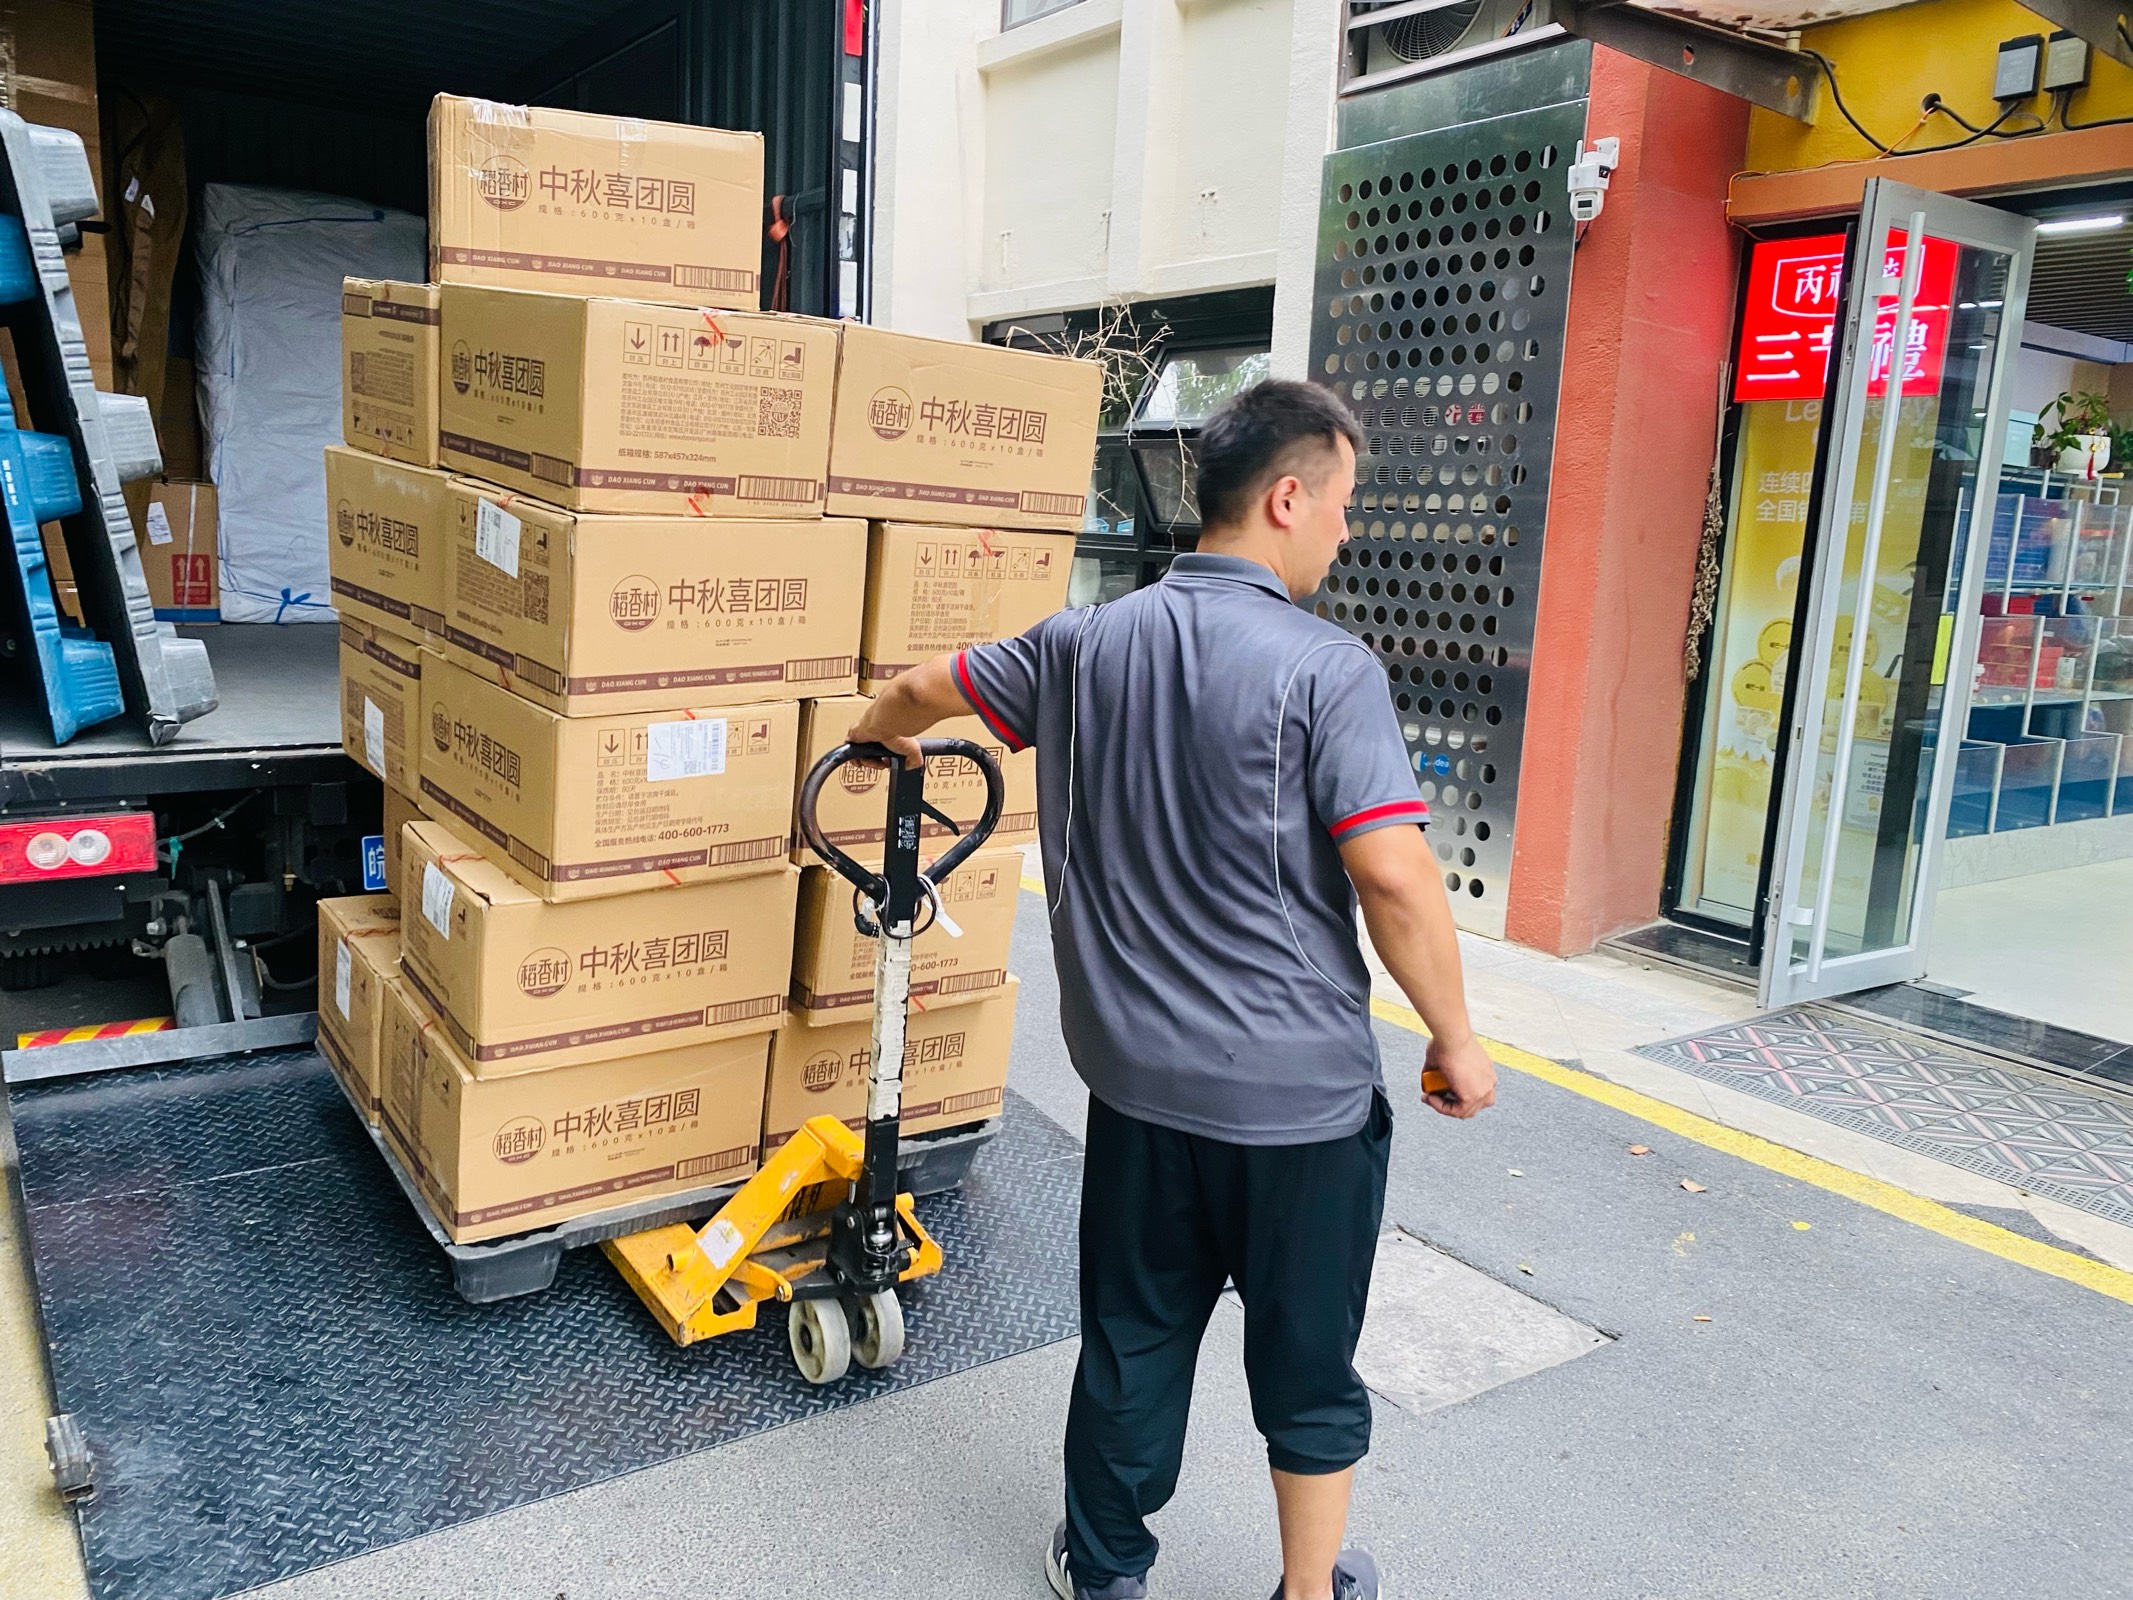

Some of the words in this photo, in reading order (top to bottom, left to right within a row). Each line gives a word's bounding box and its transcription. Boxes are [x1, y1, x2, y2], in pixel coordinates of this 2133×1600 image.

[481, 168, 528, 199] 稻香村
[539, 164, 695, 216] 中秋喜团圆
[635, 268, 652, 277] XIANG
[654, 270, 666, 278] CUN
[474, 348, 545, 399] 中秋喜团圆
[870, 399, 911, 428] 稻香村
[920, 396, 1048, 444] 中秋喜团圆
[623, 477, 643, 485] XIANG
[357, 508, 418, 558] 中秋喜团圆
[612, 588, 658, 618] 稻香村
[668, 578, 808, 615] 中秋喜团圆
[454, 718, 520, 789] 中秋喜团圆
[658, 824, 729, 841] 400-600-1773
[579, 930, 729, 979] 中秋喜团圆
[520, 958, 569, 988] 稻香村
[850, 1032, 965, 1075] 中喜团圆
[804, 1059, 841, 1085] 稻香村
[554, 1088, 700, 1143] 中秋喜团圆
[496, 1125, 542, 1156] 稻香村
